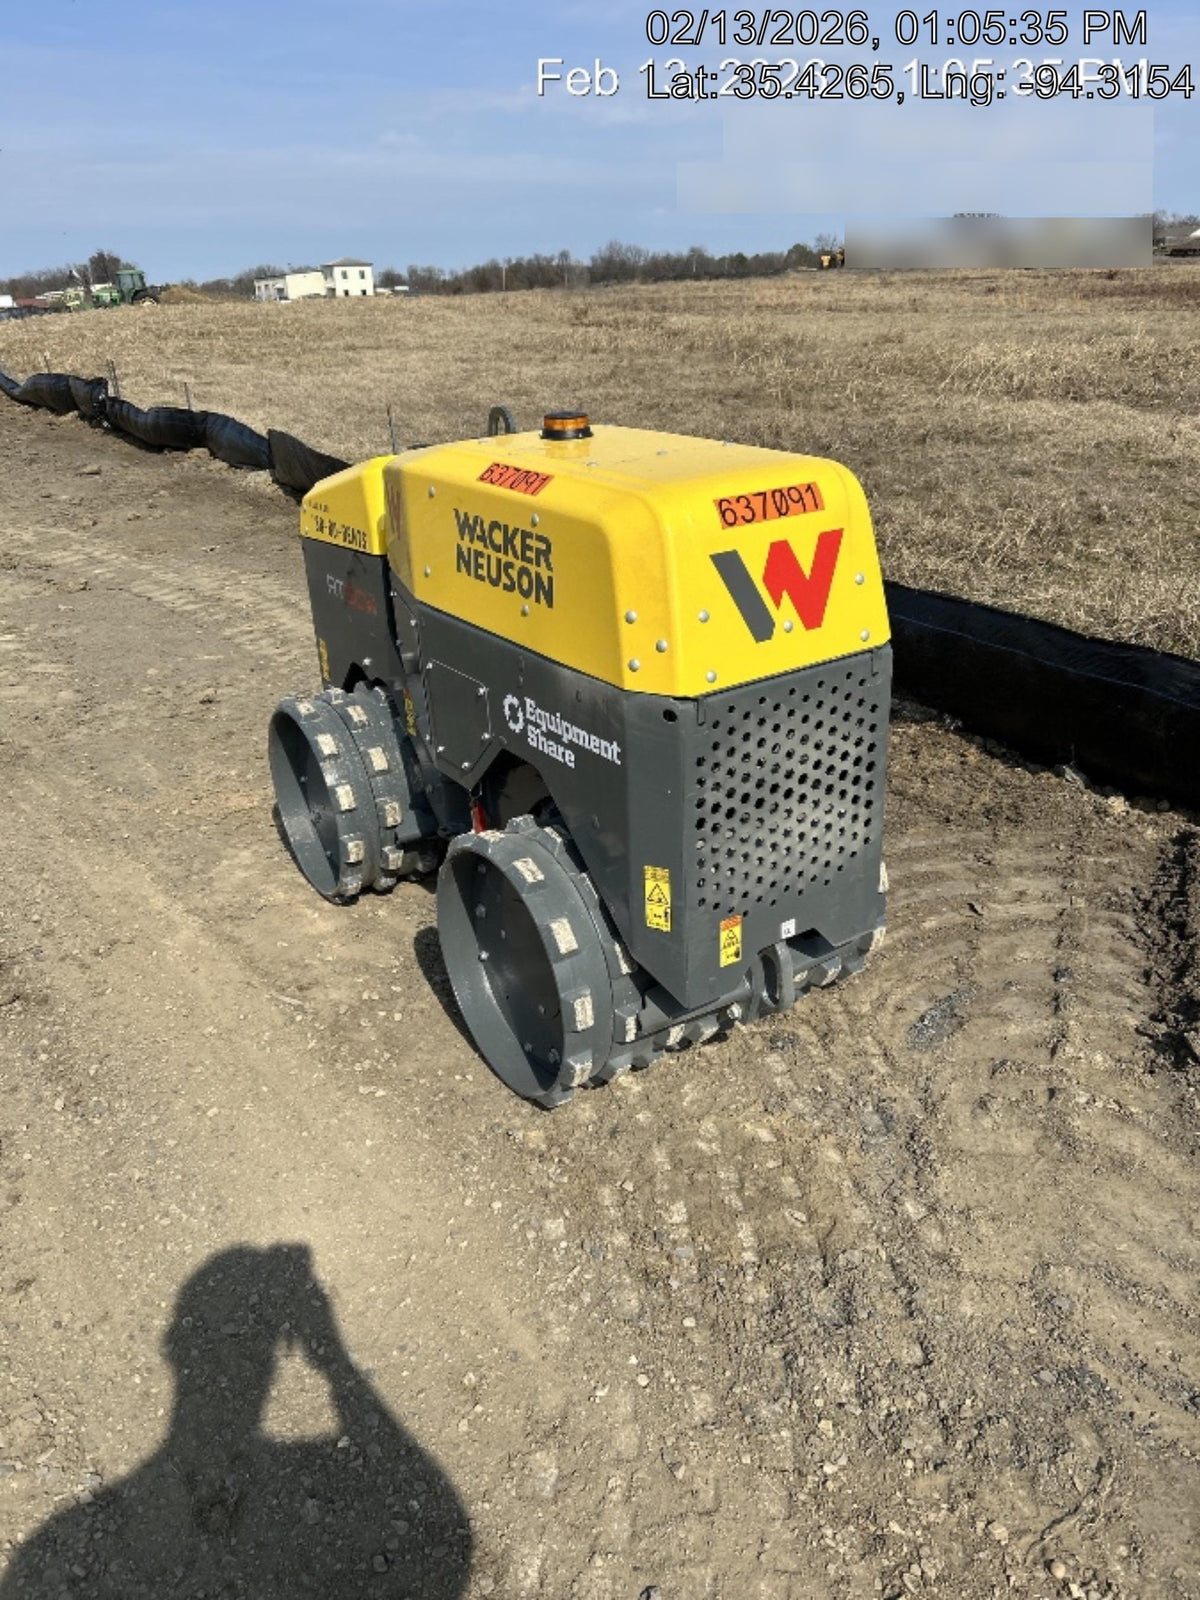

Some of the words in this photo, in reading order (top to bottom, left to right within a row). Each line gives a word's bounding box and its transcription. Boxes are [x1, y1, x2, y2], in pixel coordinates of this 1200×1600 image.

[479, 463, 549, 495] 637091
[719, 484, 819, 526] 637091
[453, 508, 553, 571] WACKER
[456, 543, 554, 608] NEUSON
[524, 696, 622, 766] Equipment
[528, 724, 575, 768] Share
